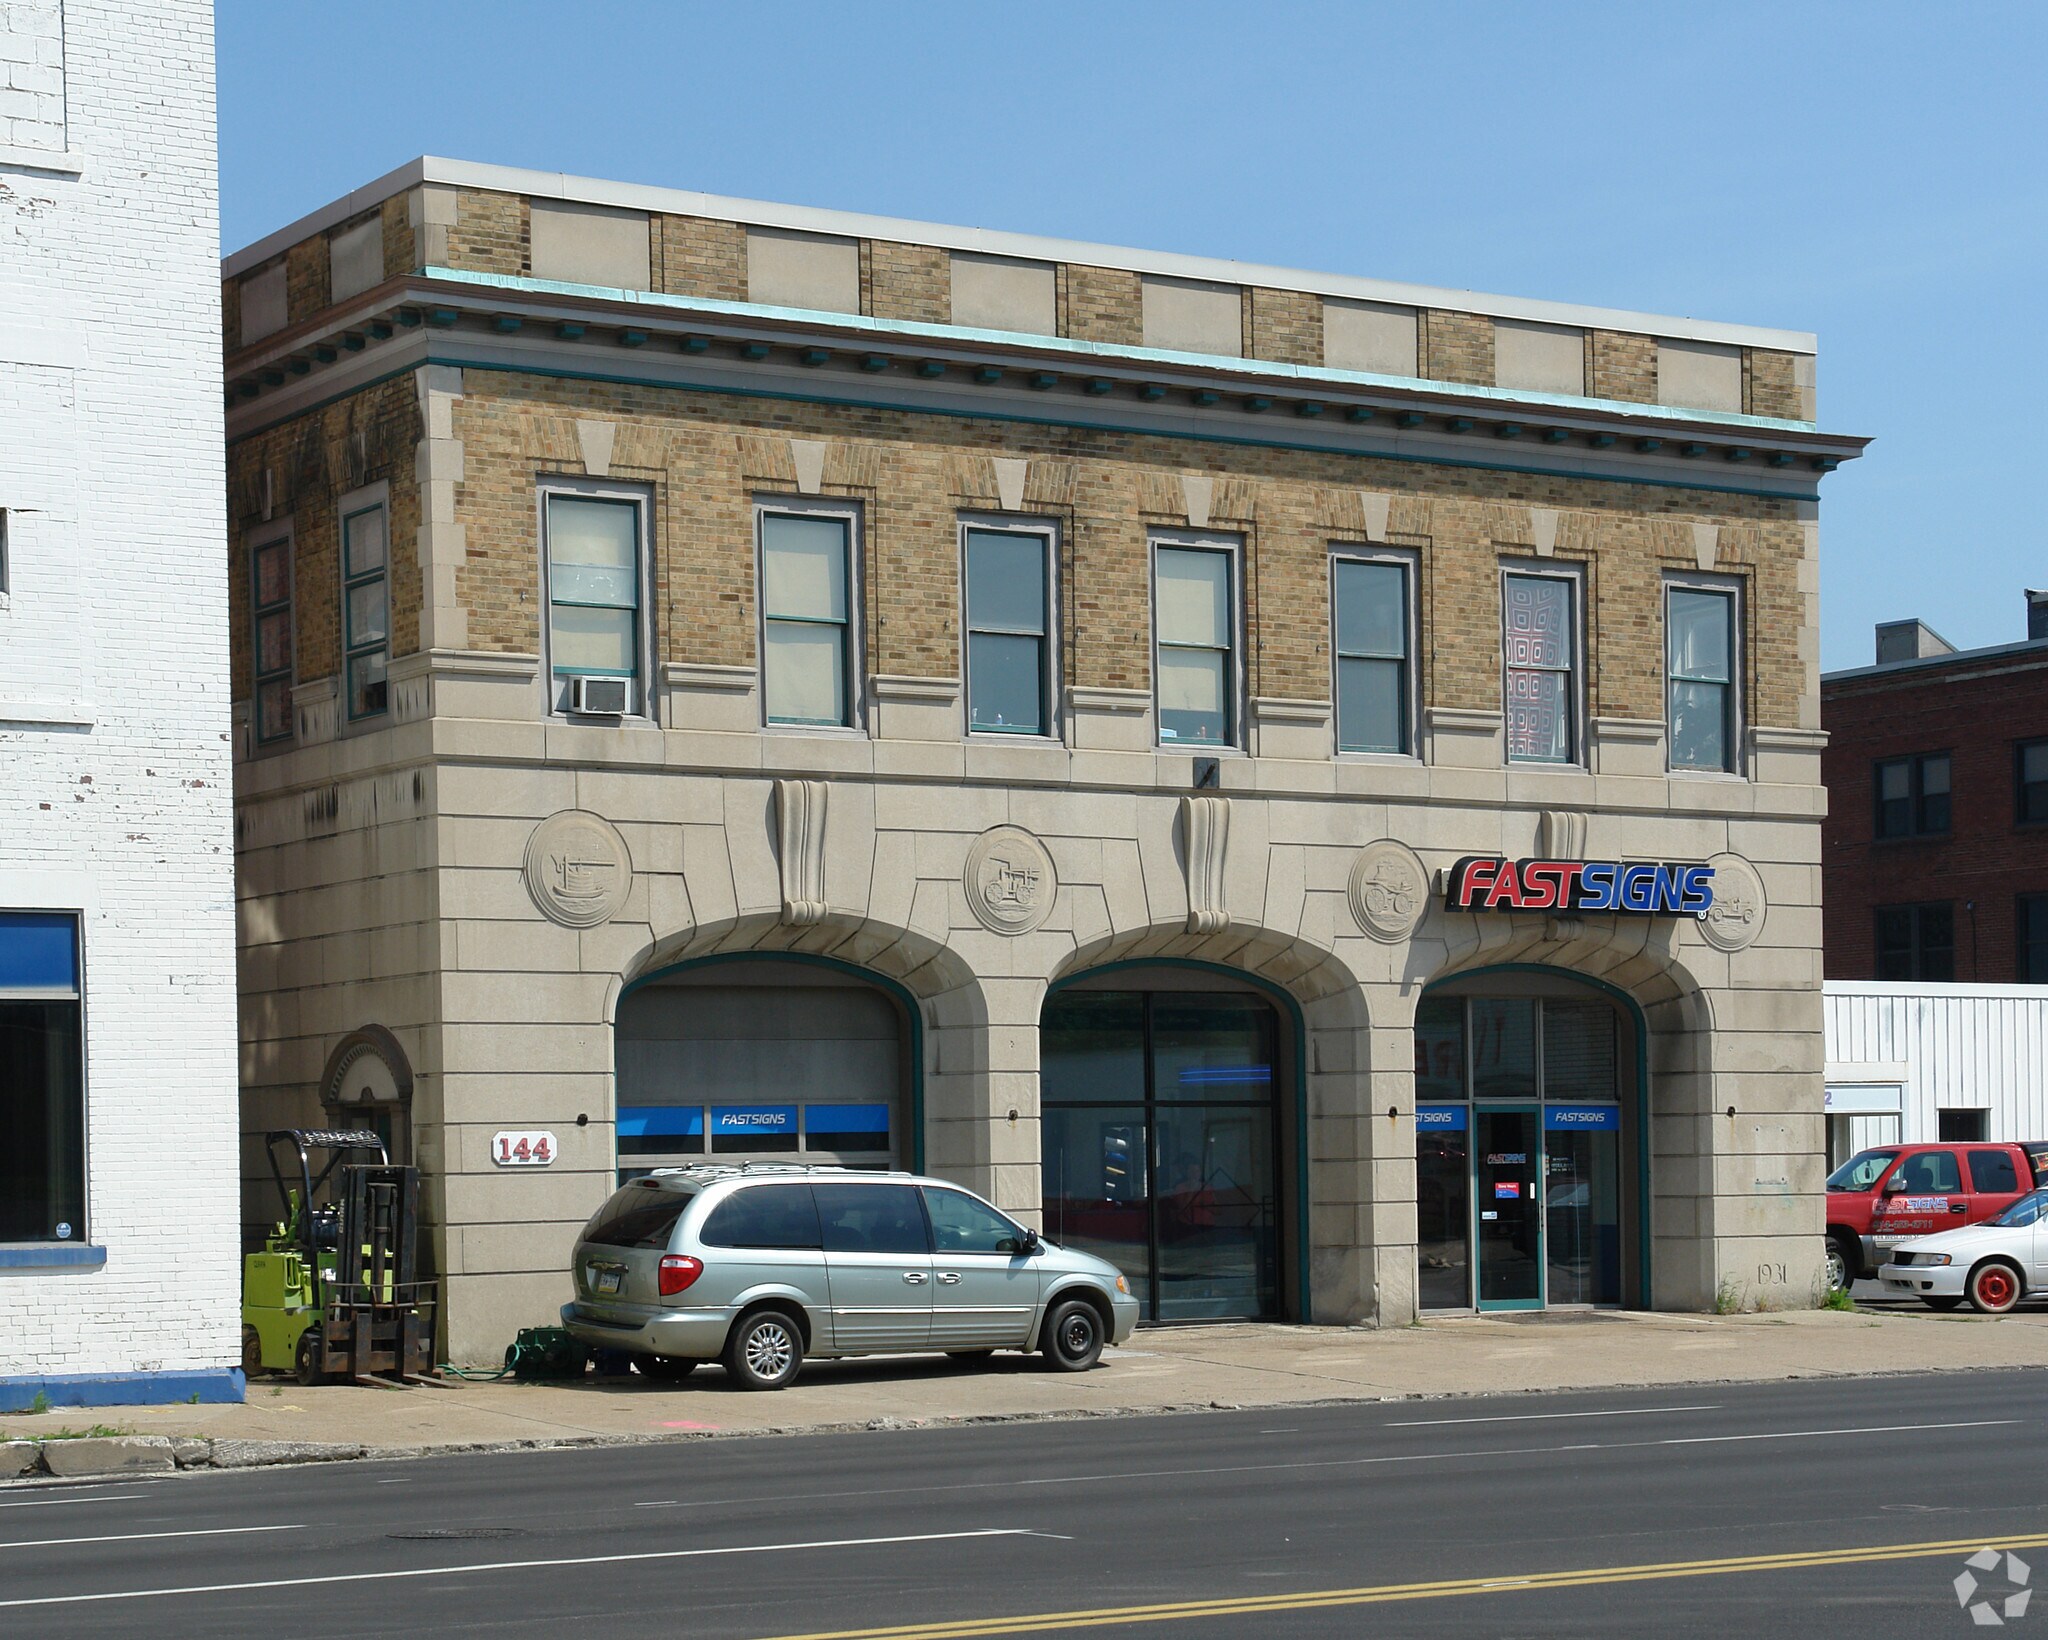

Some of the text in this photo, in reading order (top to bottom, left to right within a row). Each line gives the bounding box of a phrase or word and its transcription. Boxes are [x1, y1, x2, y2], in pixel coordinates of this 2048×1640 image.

[1459, 860, 1716, 912] FASTSIGNS
[722, 1114, 785, 1125] FASTSIGNS
[1555, 1112, 1605, 1122] FASTSIGNS
[499, 1137, 551, 1162] 144
[1758, 1263, 1787, 1285] 1931
